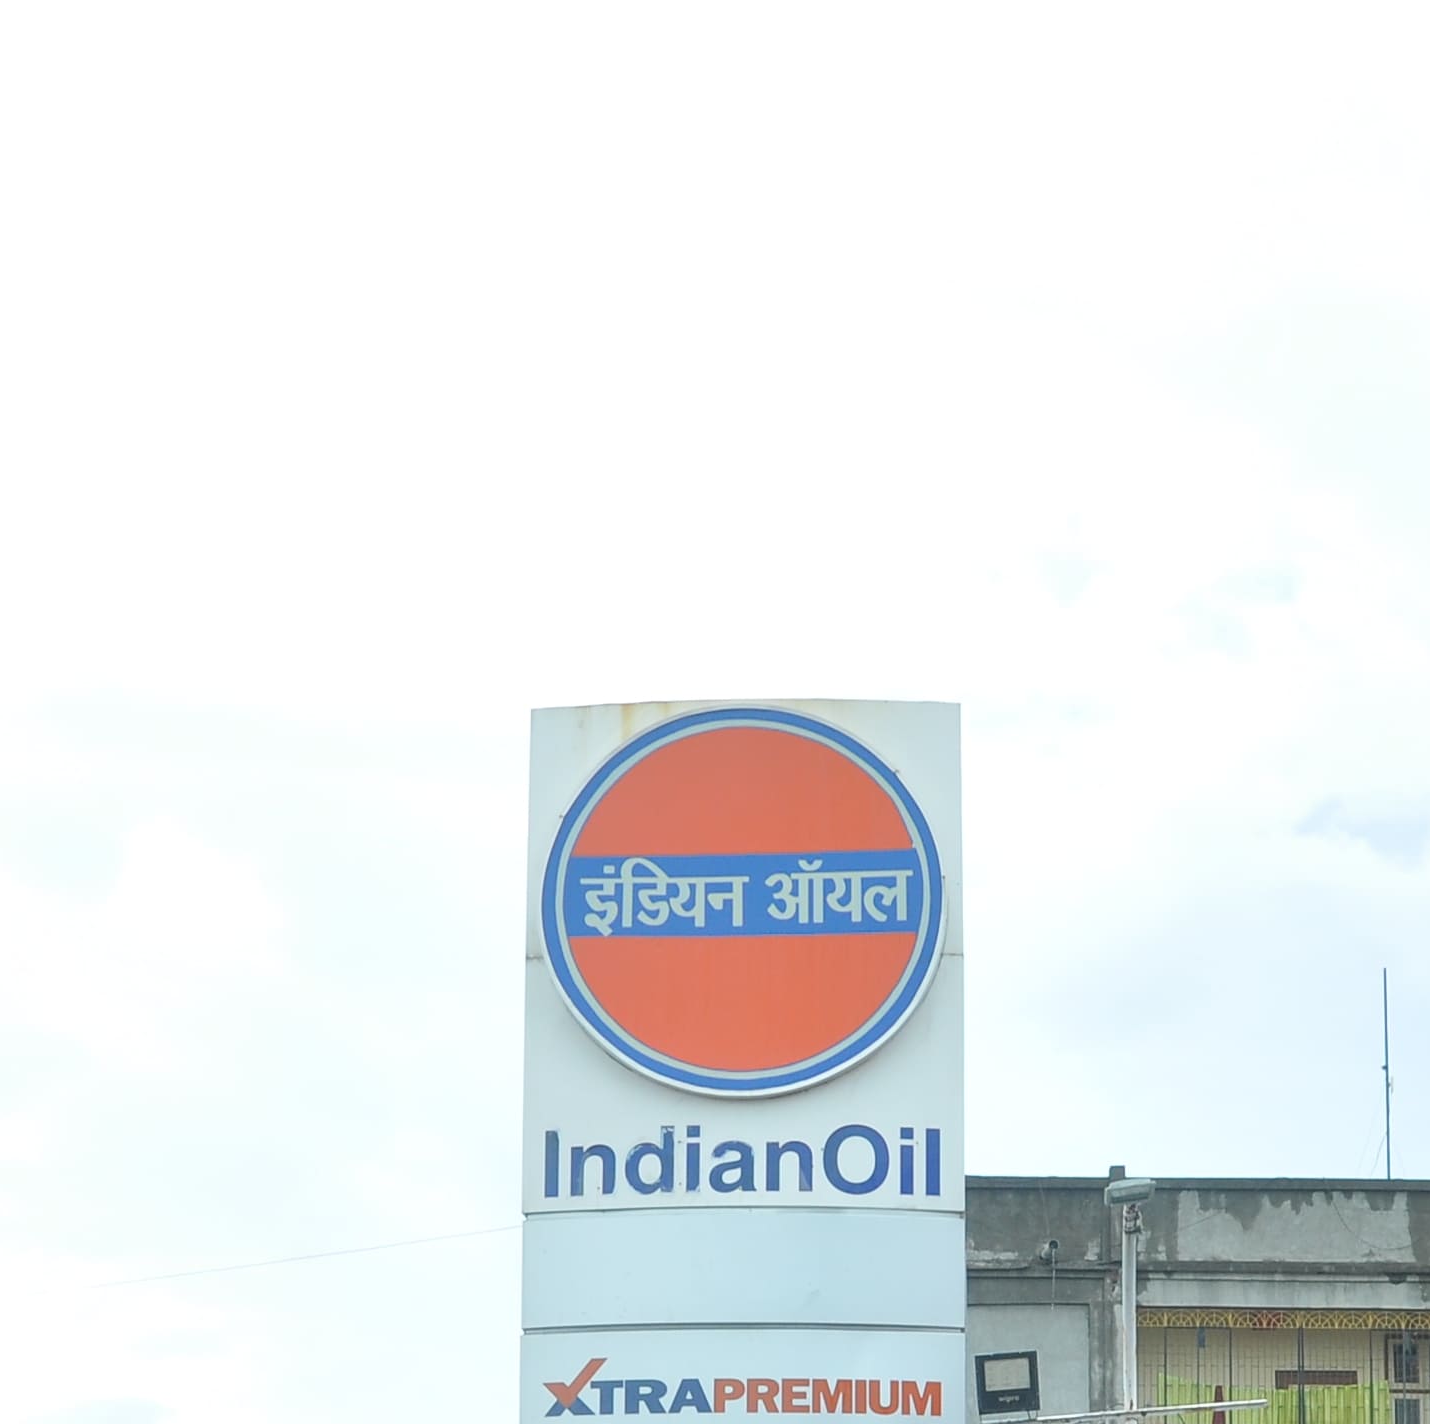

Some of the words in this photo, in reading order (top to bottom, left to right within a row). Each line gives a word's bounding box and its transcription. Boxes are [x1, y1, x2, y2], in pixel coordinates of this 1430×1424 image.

[580, 858, 750, 937] इंडियन
[765, 859, 914, 925] ऑयल
[544, 1123, 941, 1198] IndianOil
[542, 1357, 942, 1418] XTRAPREMIUM
